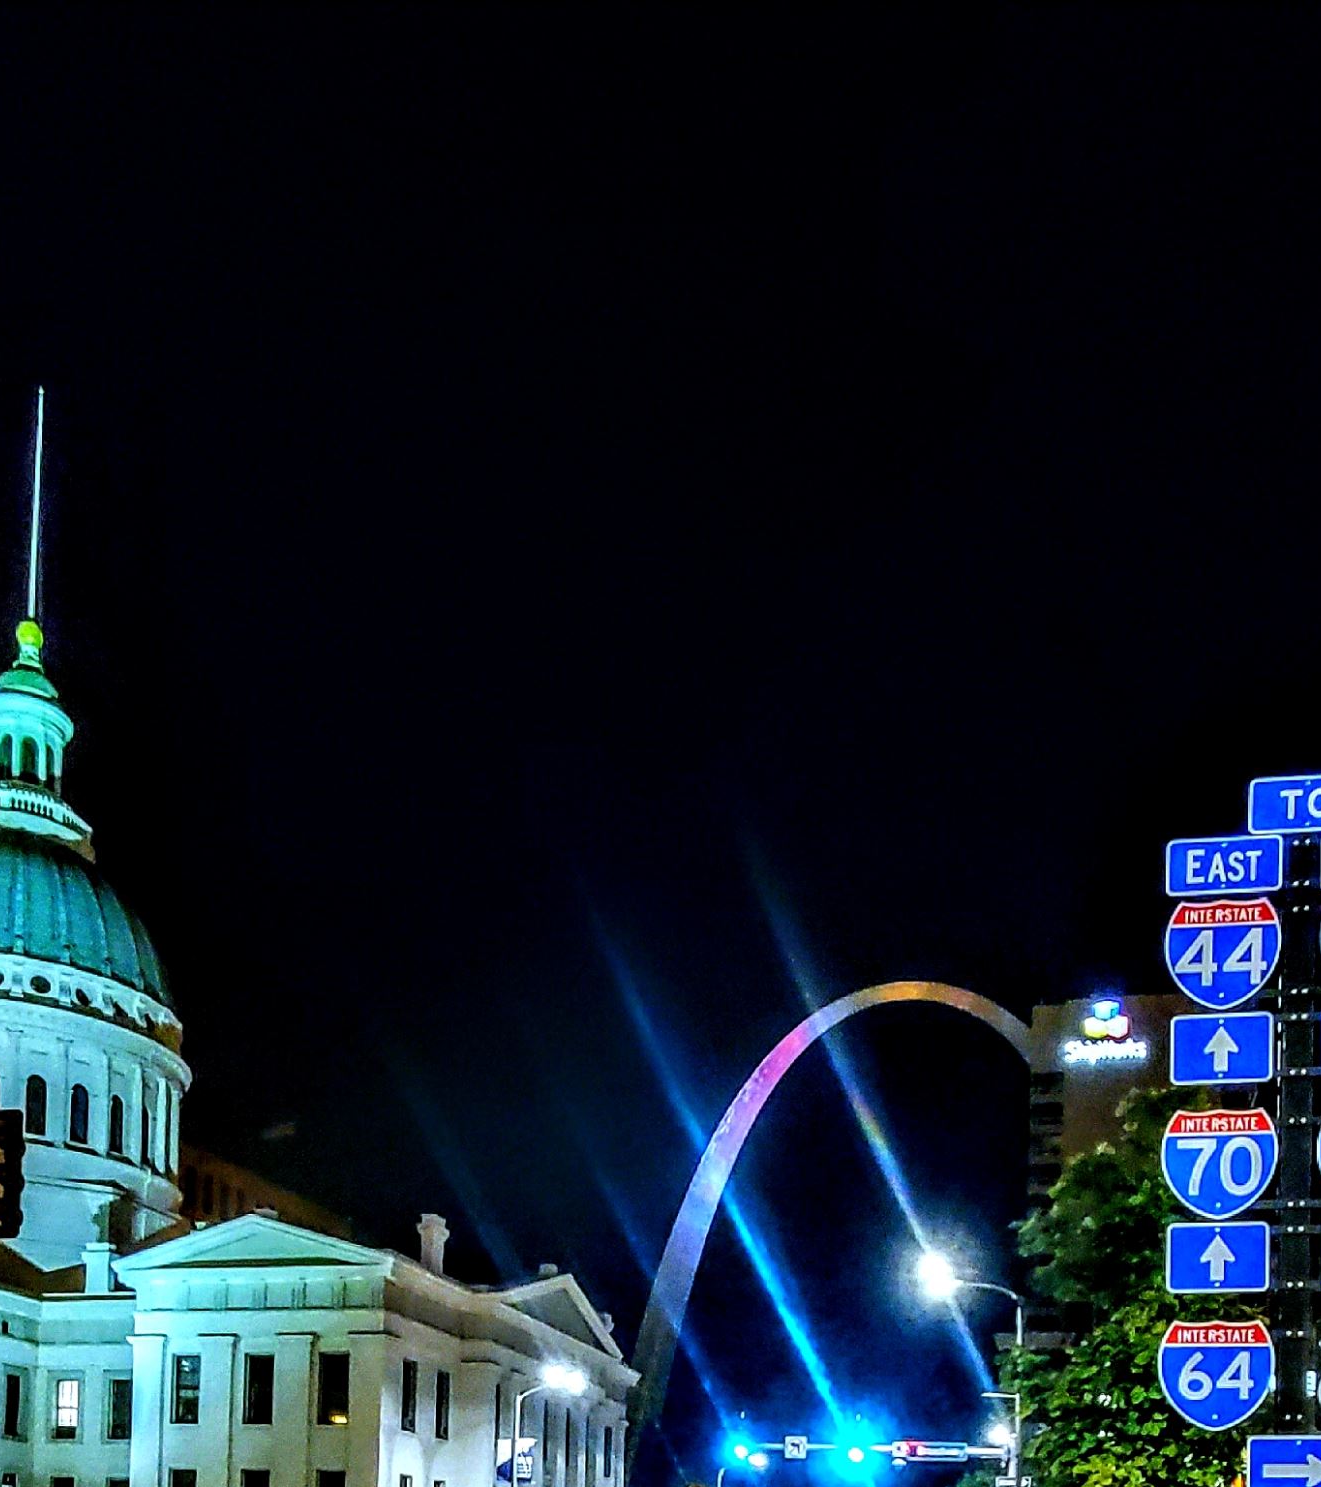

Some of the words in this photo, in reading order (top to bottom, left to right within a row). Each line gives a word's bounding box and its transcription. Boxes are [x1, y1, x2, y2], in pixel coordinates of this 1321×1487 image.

[1185, 849, 1263, 885] EAST
[1184, 907, 1263, 924] INTERSTATE
[1174, 927, 1268, 987] 44
[1180, 1116, 1259, 1132] INTERSTATE
[1176, 1137, 1263, 1197] 70
[1177, 1327, 1257, 1343] INTERSTATE
[1177, 1350, 1255, 1400] 64
